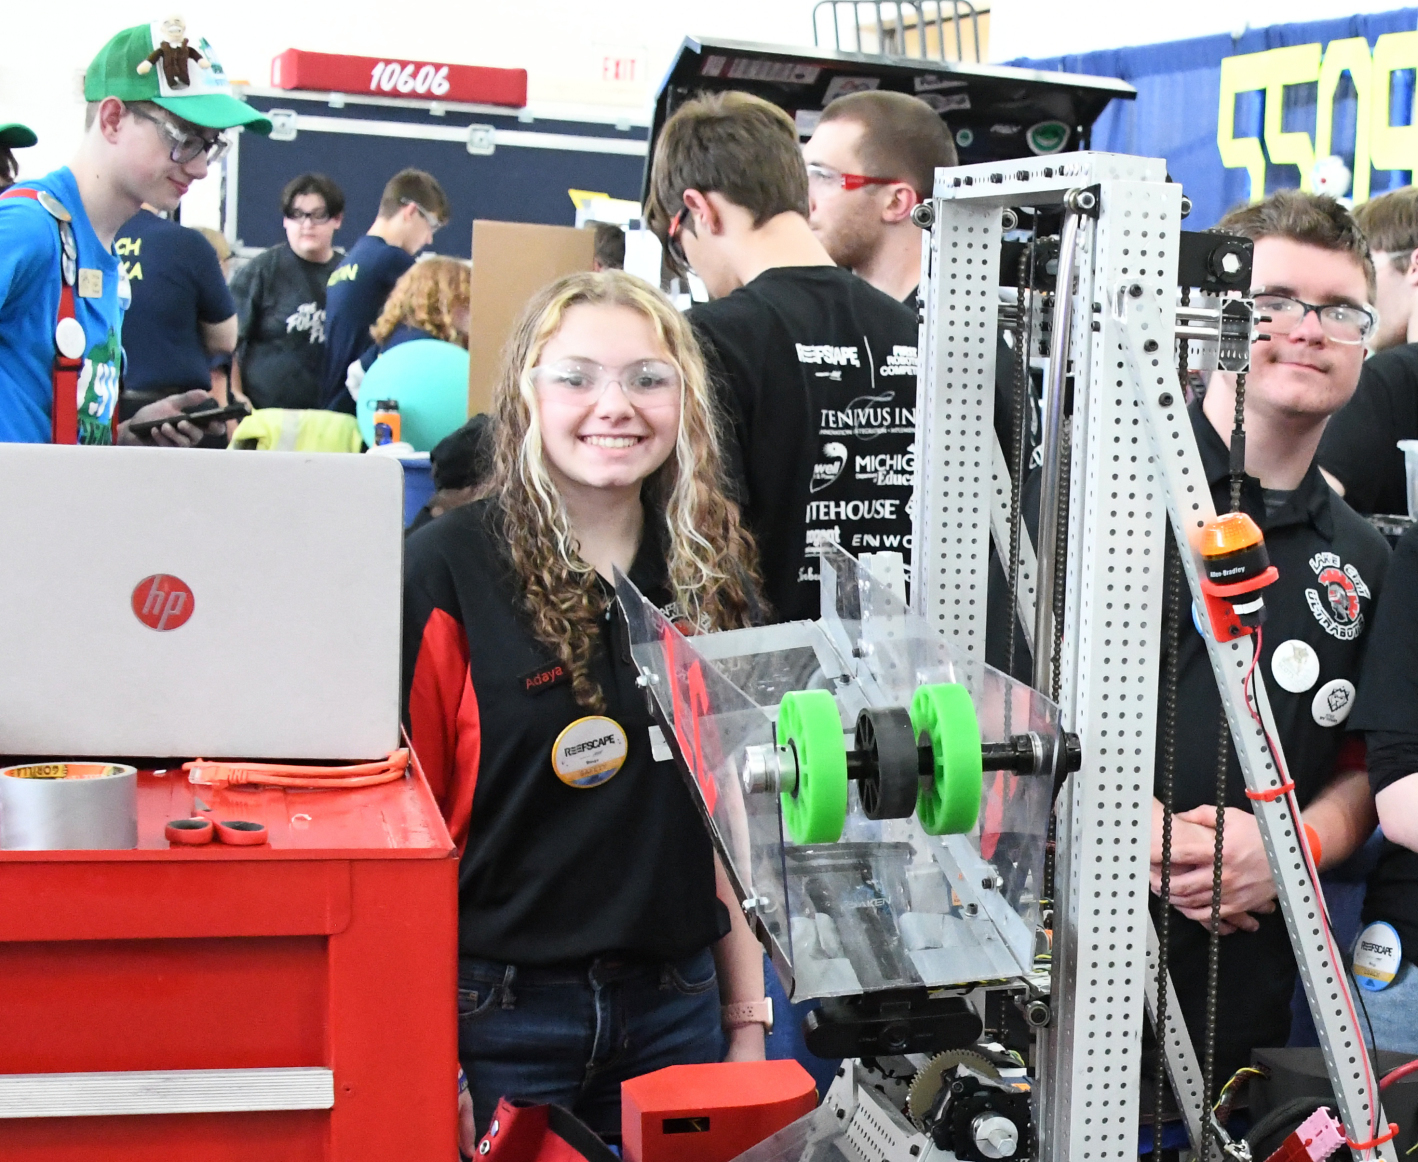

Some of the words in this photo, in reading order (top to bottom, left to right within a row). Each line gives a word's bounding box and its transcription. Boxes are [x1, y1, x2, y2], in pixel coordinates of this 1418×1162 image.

[370, 61, 450, 95] 10606
[603, 57, 636, 81] EXIT
[142, 574, 187, 632] hp
[526, 665, 564, 690] Adaya
[564, 734, 616, 758] REEFSCAPE
